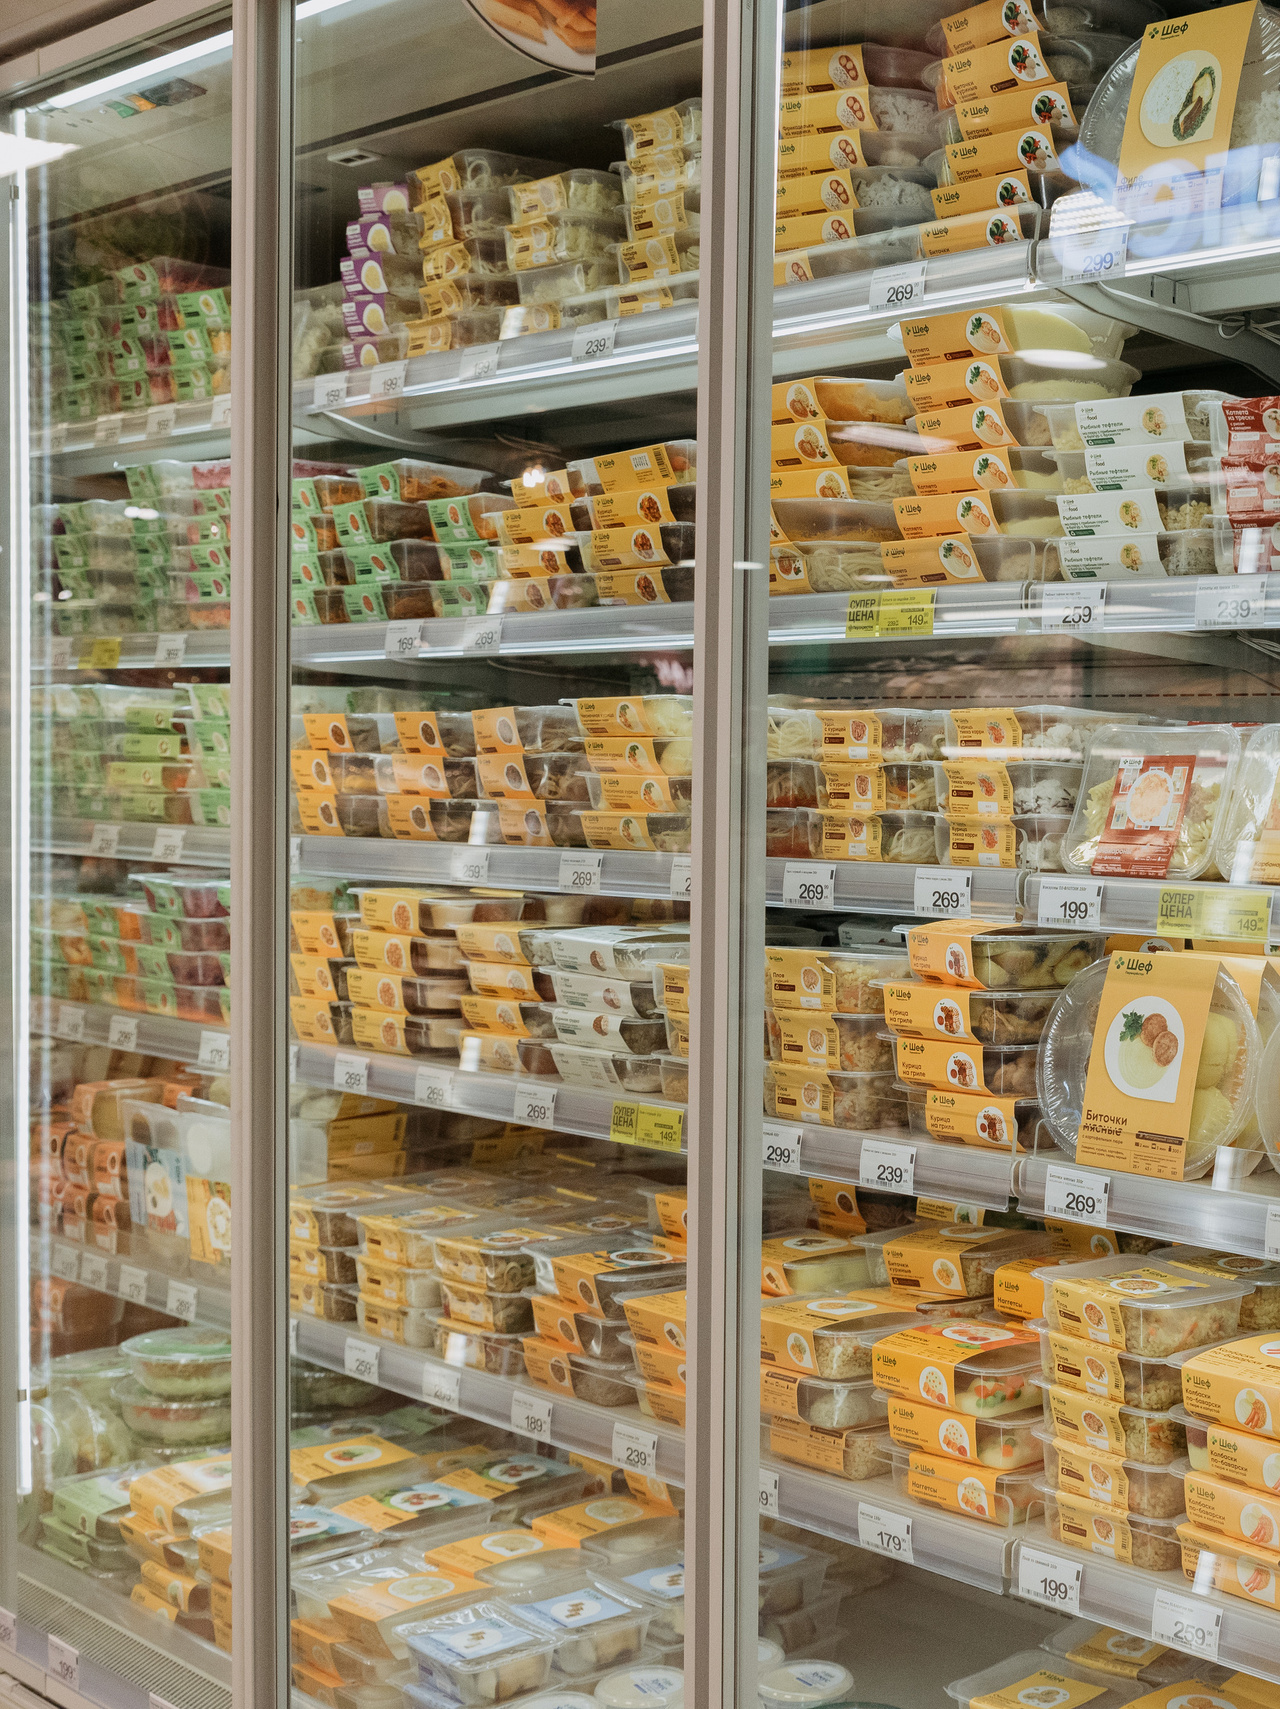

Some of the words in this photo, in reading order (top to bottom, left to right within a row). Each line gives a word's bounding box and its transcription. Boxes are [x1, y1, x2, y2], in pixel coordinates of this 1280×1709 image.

[1161, 22, 1188, 39] Шеф
[955, 60, 973, 72] Шеф
[969, 105, 989, 117] Шеф
[959, 146, 977, 158] Шеф
[1083, 252, 1114, 274] 299
[887, 284, 913, 303] 269
[912, 324, 930, 337] Шеф
[584, 337, 607, 356] 239
[914, 373, 932, 385] Шеф
[925, 418, 941, 430] Шеф
[920, 461, 938, 473] Шеф
[905, 503, 922, 515] Шеф
[850, 598, 876, 610] СУПЕР
[1218, 599, 1250, 618] 239
[848, 609, 875, 623] ЦЕНА
[908, 614, 925, 626] 149
[1062, 605, 1093, 624] 259
[572, 871, 592, 887] 269
[799, 883, 824, 901] 269
[1161, 892, 1195, 906] СУПЕР
[932, 890, 960, 909] 269
[1060, 900, 1088, 920] 199
[1160, 904, 1193, 920] ЦЕНА
[1237, 917, 1258, 933] 149
[1126, 957, 1153, 976] Шеф
[896, 989, 912, 1001] Шеф
[909, 1042, 925, 1054] Шеф
[902, 1062, 922, 1071] Курица
[939, 1095, 956, 1107] Шеф
[527, 1103, 547, 1120] 269
[613, 1104, 636, 1117] СУПЕР
[612, 1116, 634, 1129] ЦЕНА
[930, 1115, 951, 1124] Курица
[1086, 1109, 1128, 1127] Биточки
[659, 1130, 675, 1142] 149
[766, 1145, 791, 1164] 299
[877, 1164, 903, 1183] 239
[1065, 1192, 1096, 1214] 269
[1005, 1280, 1020, 1293] Шеф
[882, 1354, 897, 1367] Шеф
[1193, 1375, 1211, 1389] Шеф
[524, 1413, 544, 1433] 189
[1218, 1438, 1237, 1452] Шеф
[625, 1446, 648, 1466] 239
[1196, 1486, 1215, 1501] Шеф
[877, 1530, 901, 1551] 179
[1040, 1576, 1068, 1600] 199
[1173, 1621, 1206, 1647] 259
